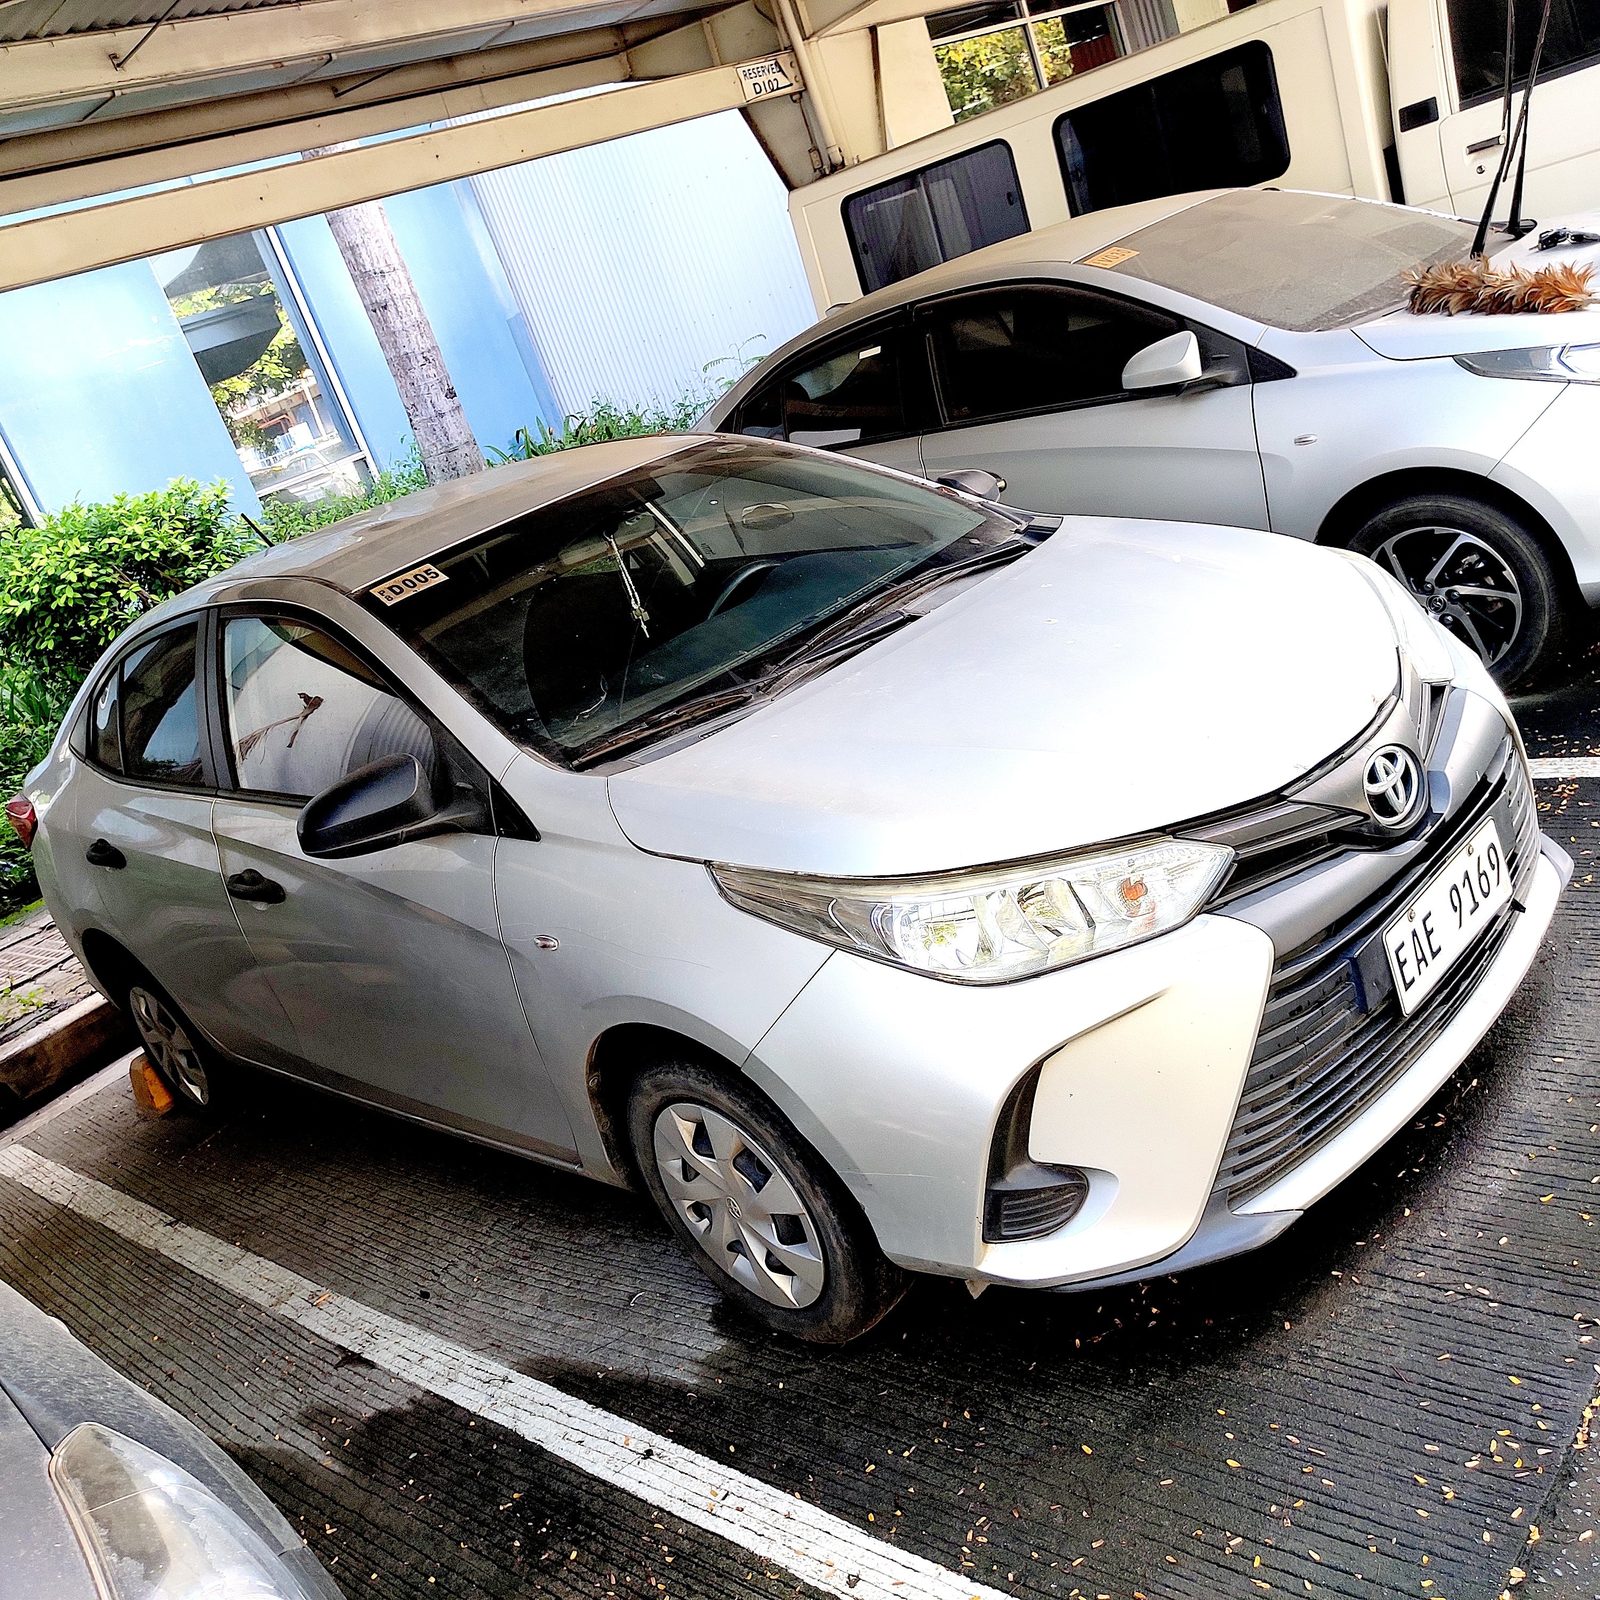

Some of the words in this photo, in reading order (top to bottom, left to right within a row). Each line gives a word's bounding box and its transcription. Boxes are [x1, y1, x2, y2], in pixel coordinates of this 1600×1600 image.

[386, 568, 440, 596] D005
[1394, 910, 1442, 992] EAE
[1449, 842, 1500, 930] 9169
